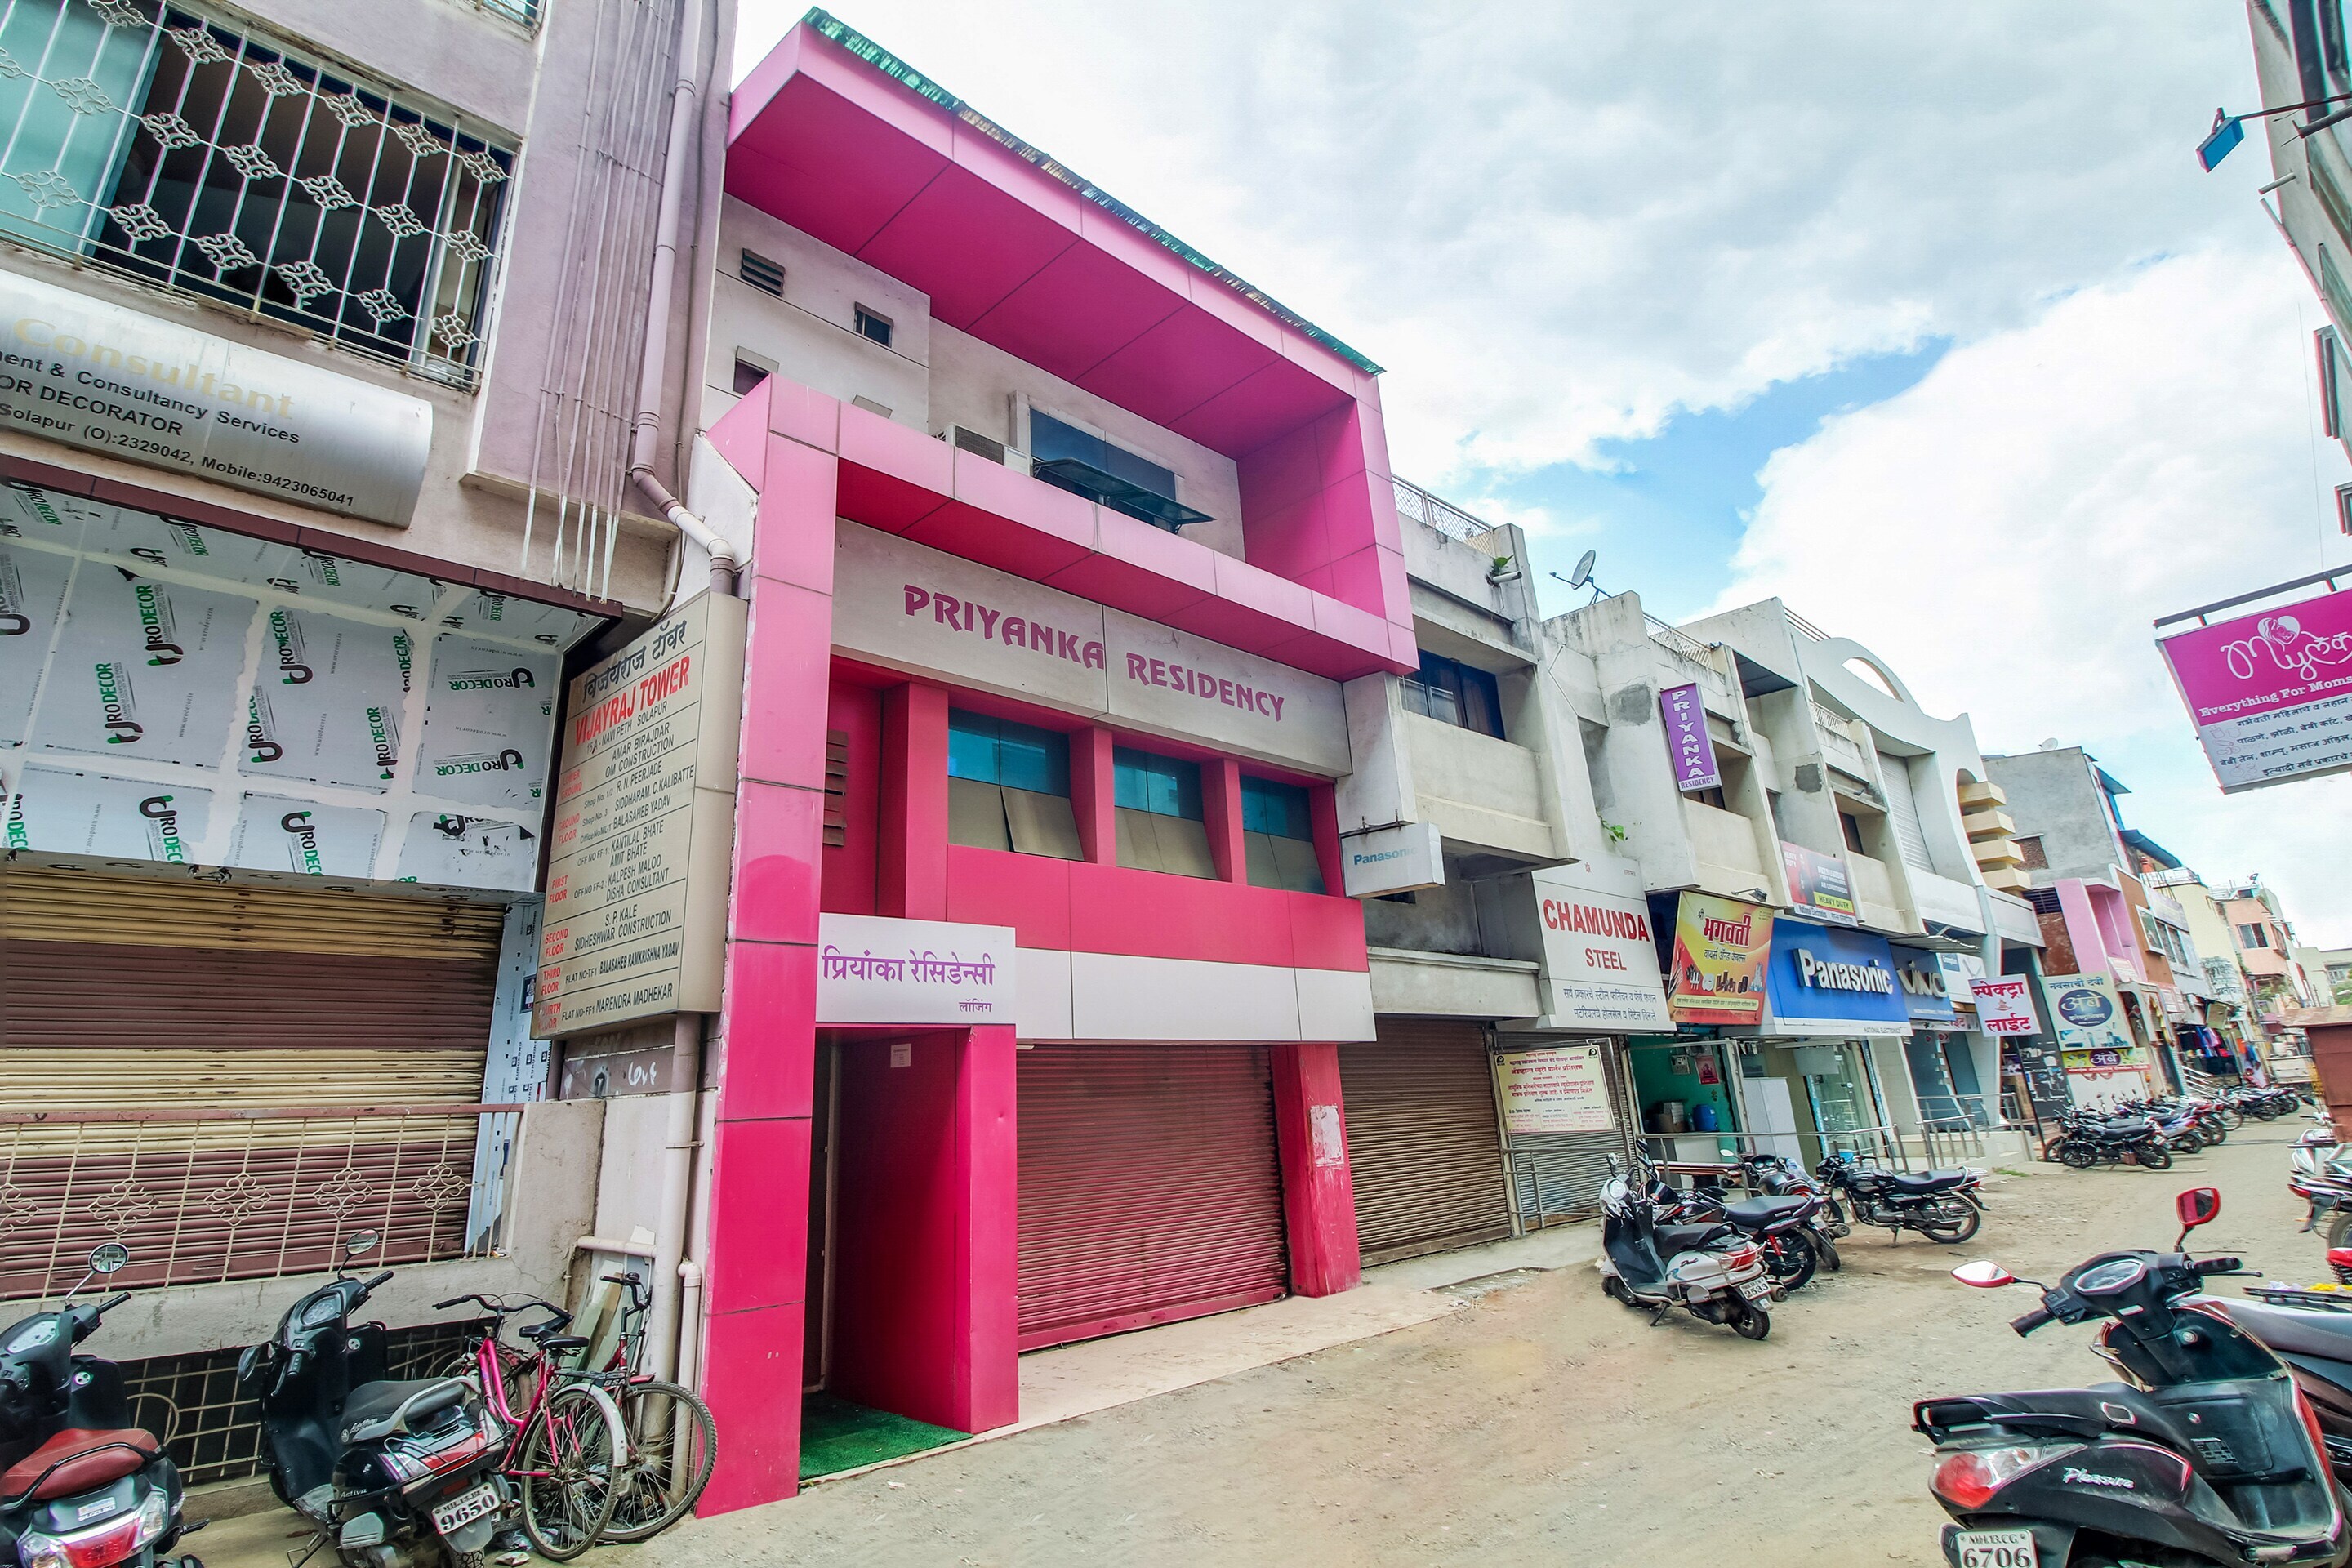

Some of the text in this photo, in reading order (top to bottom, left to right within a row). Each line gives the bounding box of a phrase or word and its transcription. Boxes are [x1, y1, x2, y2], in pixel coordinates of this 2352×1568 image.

[14, 318, 295, 420] Consultant
[40, 386, 184, 437] DECORATOR
[49, 363, 65, 378] &
[77, 371, 207, 420] Consultancy
[217, 410, 300, 444] Services
[0, 403, 76, 432] Solapur
[202, 457, 354, 507] Mobile:9423065041
[652, 620, 688, 661] टॉवर
[902, 584, 1285, 723] PRIYANKA RESIDENCY
[575, 655, 690, 746] VIJAYRAJ TOWER
[2198, 675, 2352, 717] Everything For Moms
[2236, 696, 2349, 727] गर्भवती महिलांचे व लहान
[636, 701, 668, 727] SOLAPUR
[612, 722, 670, 762] AMAR BIRAJDAR
[1671, 689, 1705, 779] PRIYANKA
[605, 734, 675, 778] OM CONSTRUCTION
[2219, 755, 2237, 766] बेबी
[2290, 740, 2319, 751] मसाज
[2261, 752, 2349, 777] इत्यादी सर्व प्रकारचे
[630, 760, 662, 786] PEERJADE
[1680, 776, 1715, 790] RESIDENCY
[612, 794, 671, 831] BALASAHEB YADAV
[611, 830, 640, 853] KANTILAL
[643, 819, 664, 840] BHATE
[607, 866, 636, 887] KALPESH
[638, 854, 662, 872] MALOO
[609, 841, 648, 868] AMIT BHATE
[548, 889, 568, 905] FLOOR
[551, 875, 568, 889] FIRST
[606, 868, 670, 902] DISHA CONSULTANT
[619, 904, 638, 922] KALE
[1543, 898, 1650, 942] CHAMUNDA
[545, 928, 569, 945] SECOND
[574, 909, 672, 951] SIDHESHWAR CONSTRUCTION
[1703, 914, 1752, 947] भगवती
[545, 943, 564, 958] FLOOR
[565, 971, 579, 985] FLAT
[599, 958, 627, 975] BALASAHEB
[627, 946, 661, 968] RAMKRISHNA
[662, 941, 679, 959] YADAV
[821, 944, 996, 986] प्रियांका रेसिडेन्सी
[1584, 947, 1628, 971] STEEL
[543, 967, 561, 981] THIRD
[1793, 948, 1894, 995] Panasonic
[541, 981, 559, 996] FLOOR
[561, 1009, 575, 1022] FLAT
[595, 991, 631, 1013] NARENDRA
[632, 982, 673, 1004] MADHEKAR
[1971, 980, 2025, 999] स्पेक्ट्रा
[958, 998, 993, 1013] लॉजिंग
[1984, 1012, 2032, 1033] लाईट
[1744, 1283, 1769, 1298] 2533
[339, 1488, 368, 1499] Activa
[2063, 1466, 2136, 1489] Pleasure
[440, 1494, 496, 1531] 9650
[1962, 1547, 2031, 1568] 6706
